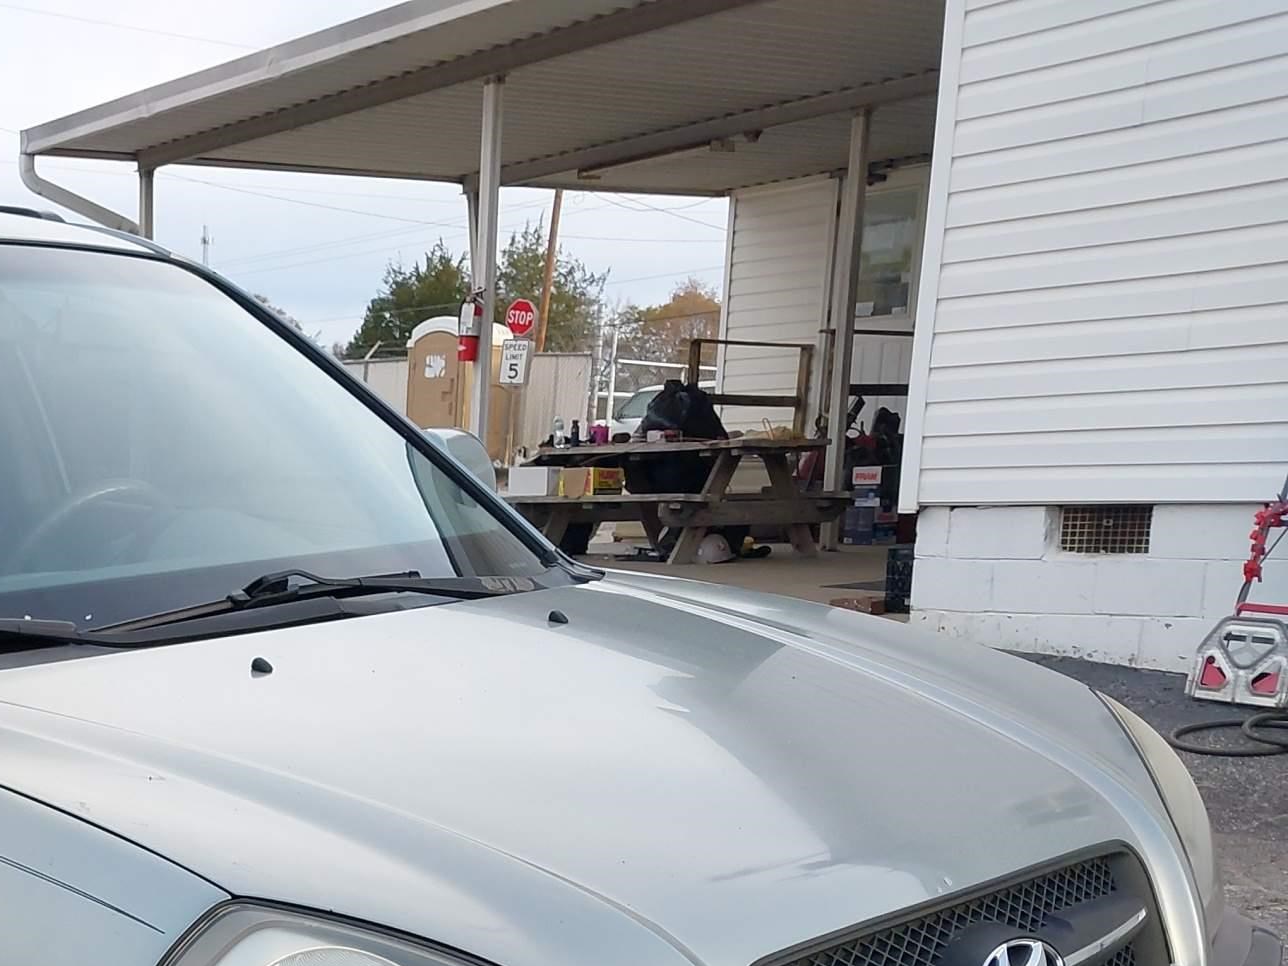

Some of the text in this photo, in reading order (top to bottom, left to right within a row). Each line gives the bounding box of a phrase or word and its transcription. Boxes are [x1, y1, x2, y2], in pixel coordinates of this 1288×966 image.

[508, 310, 534, 326] STOP
[504, 343, 528, 352] SPEED
[505, 353, 524, 361] LIMIT
[508, 363, 519, 380] 5
[855, 471, 879, 481] FRAM
